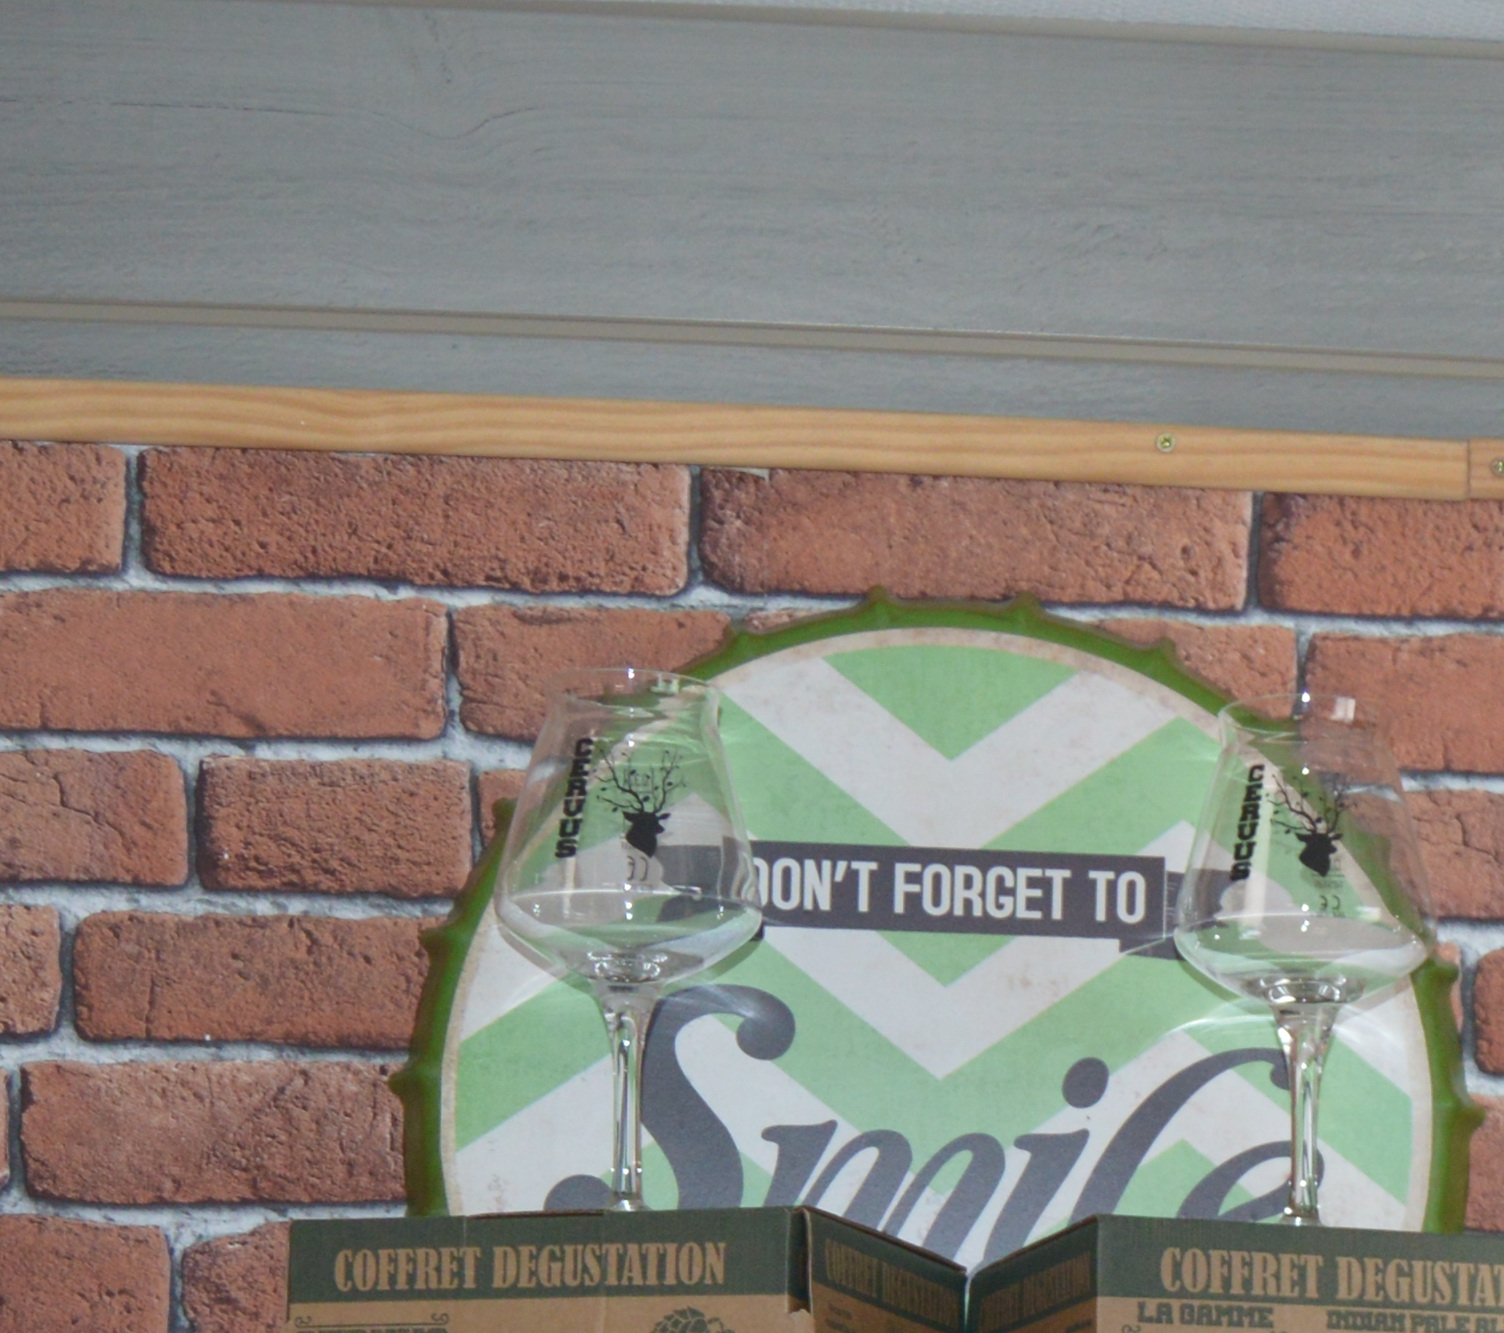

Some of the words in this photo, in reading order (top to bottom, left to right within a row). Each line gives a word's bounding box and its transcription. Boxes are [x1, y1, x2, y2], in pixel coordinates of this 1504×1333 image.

[893, 861, 1067, 923] FORGET
[1088, 868, 1149, 927] TO
[334, 1246, 481, 1292] COFFRET
[492, 1241, 727, 1288] DEGUSTATION
[1161, 1247, 1324, 1299] COFFRET
[1137, 1301, 1174, 1324] LA
[1179, 1304, 1274, 1330] GAMME
